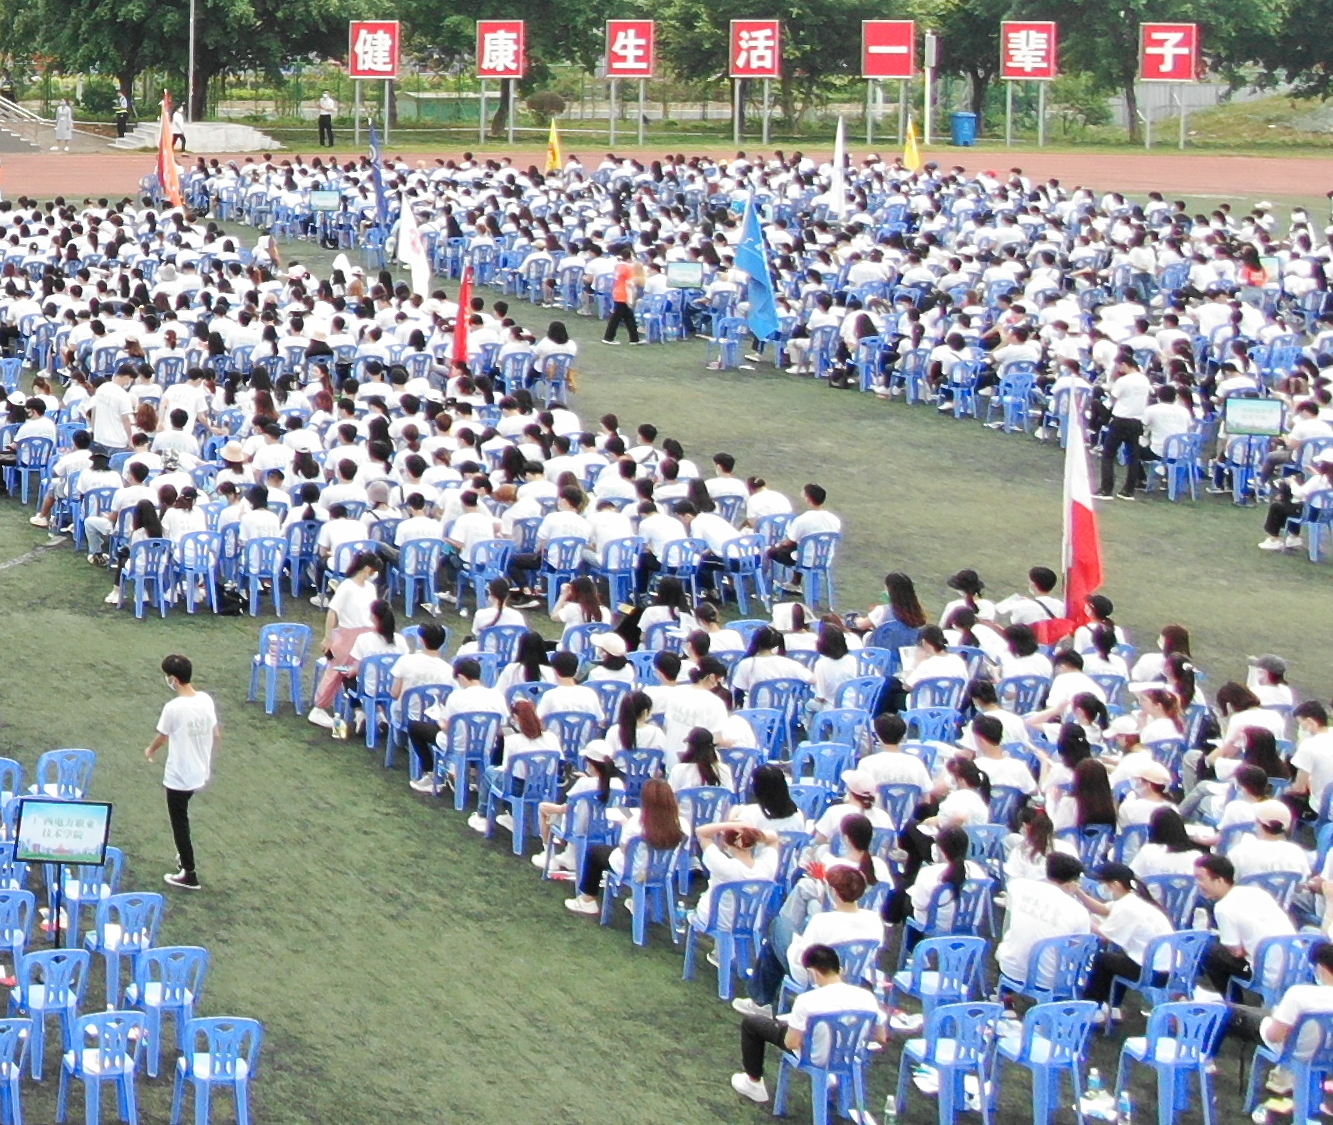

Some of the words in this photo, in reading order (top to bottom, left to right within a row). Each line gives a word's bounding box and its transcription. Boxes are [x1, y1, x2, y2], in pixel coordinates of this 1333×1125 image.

[354, 28, 393, 72] 健
[481, 29, 519, 72] 康
[612, 29, 649, 70] 生
[736, 29, 775, 71] 活
[868, 45, 909, 54] 一
[1008, 30, 1049, 73] 辈
[1145, 32, 1190, 73] 子
